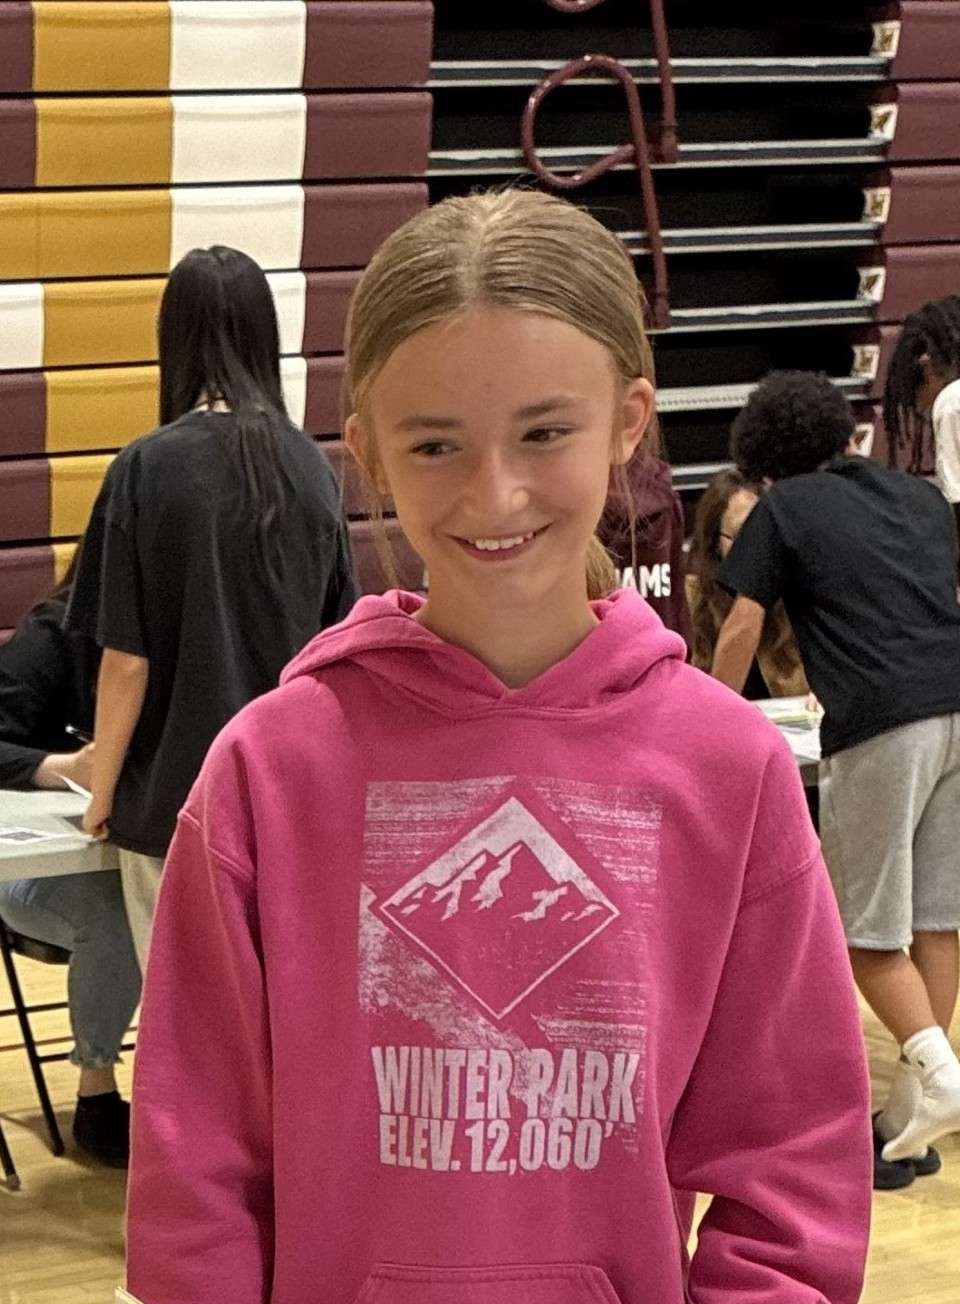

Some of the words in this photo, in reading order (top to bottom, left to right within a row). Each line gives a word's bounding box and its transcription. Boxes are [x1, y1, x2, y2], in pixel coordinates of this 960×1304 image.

[615, 563, 671, 598] AMS
[371, 1046, 514, 1120] WINTER
[526, 1048, 639, 1123] PARK
[379, 1115, 461, 1171] ELEV.
[465, 1118, 614, 1175] 12,060'
